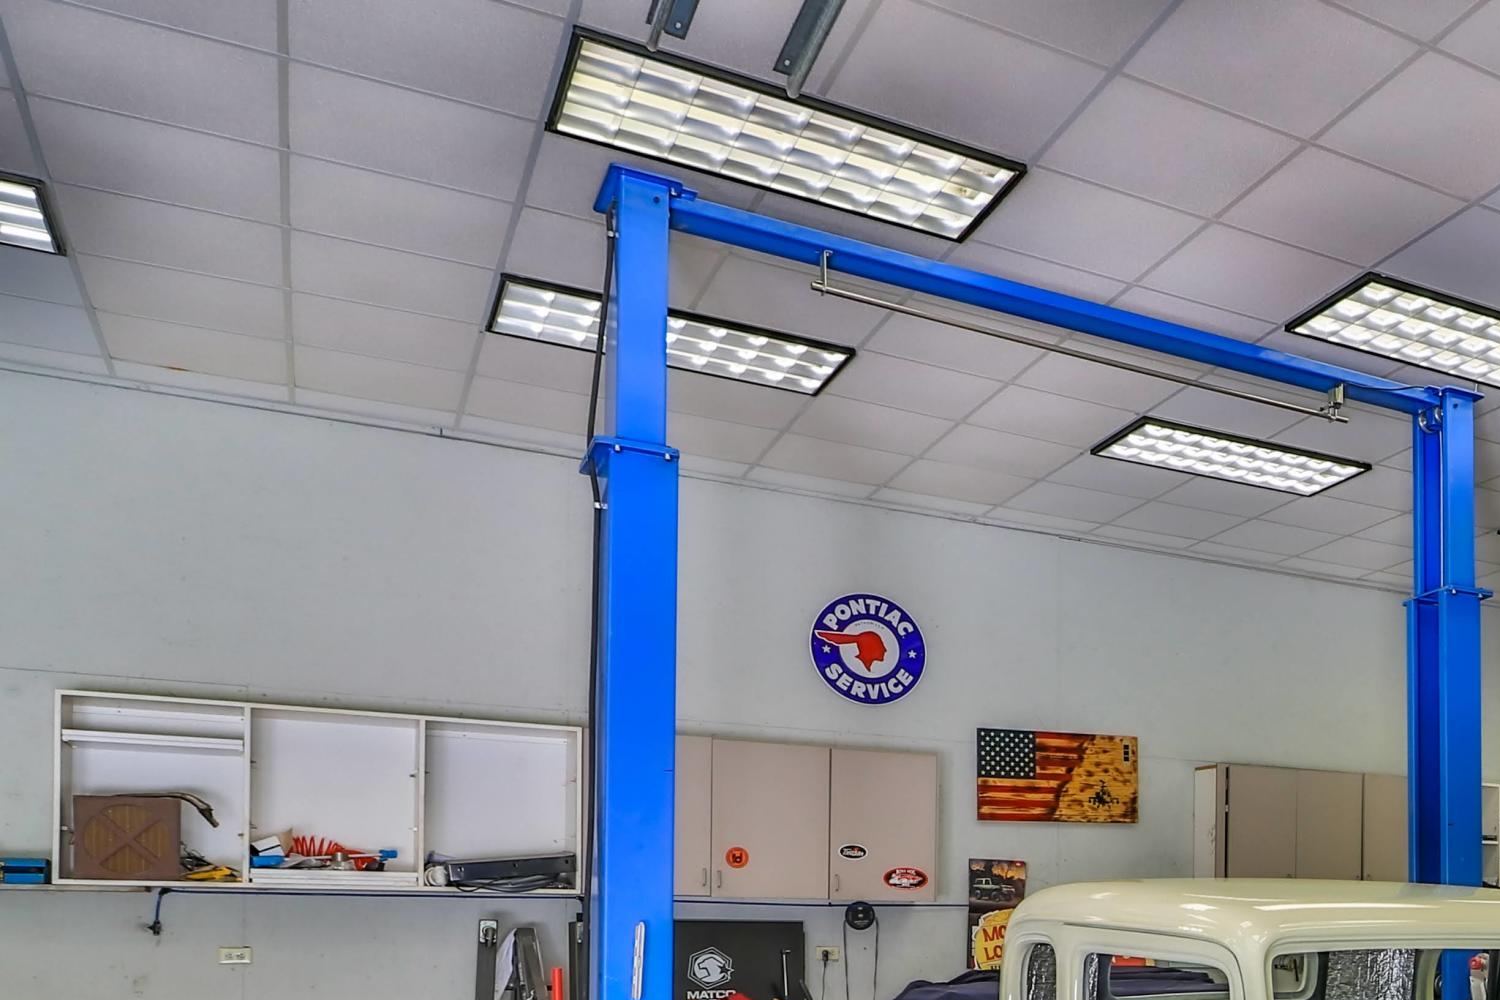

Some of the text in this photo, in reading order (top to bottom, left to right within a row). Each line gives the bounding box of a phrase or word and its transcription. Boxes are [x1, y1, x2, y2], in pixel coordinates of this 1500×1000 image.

[822, 598, 914, 637] PONTIAC
[824, 663, 914, 699] SERVICE
[982, 924, 1008, 942] MO
[983, 945, 1003, 961] LO
